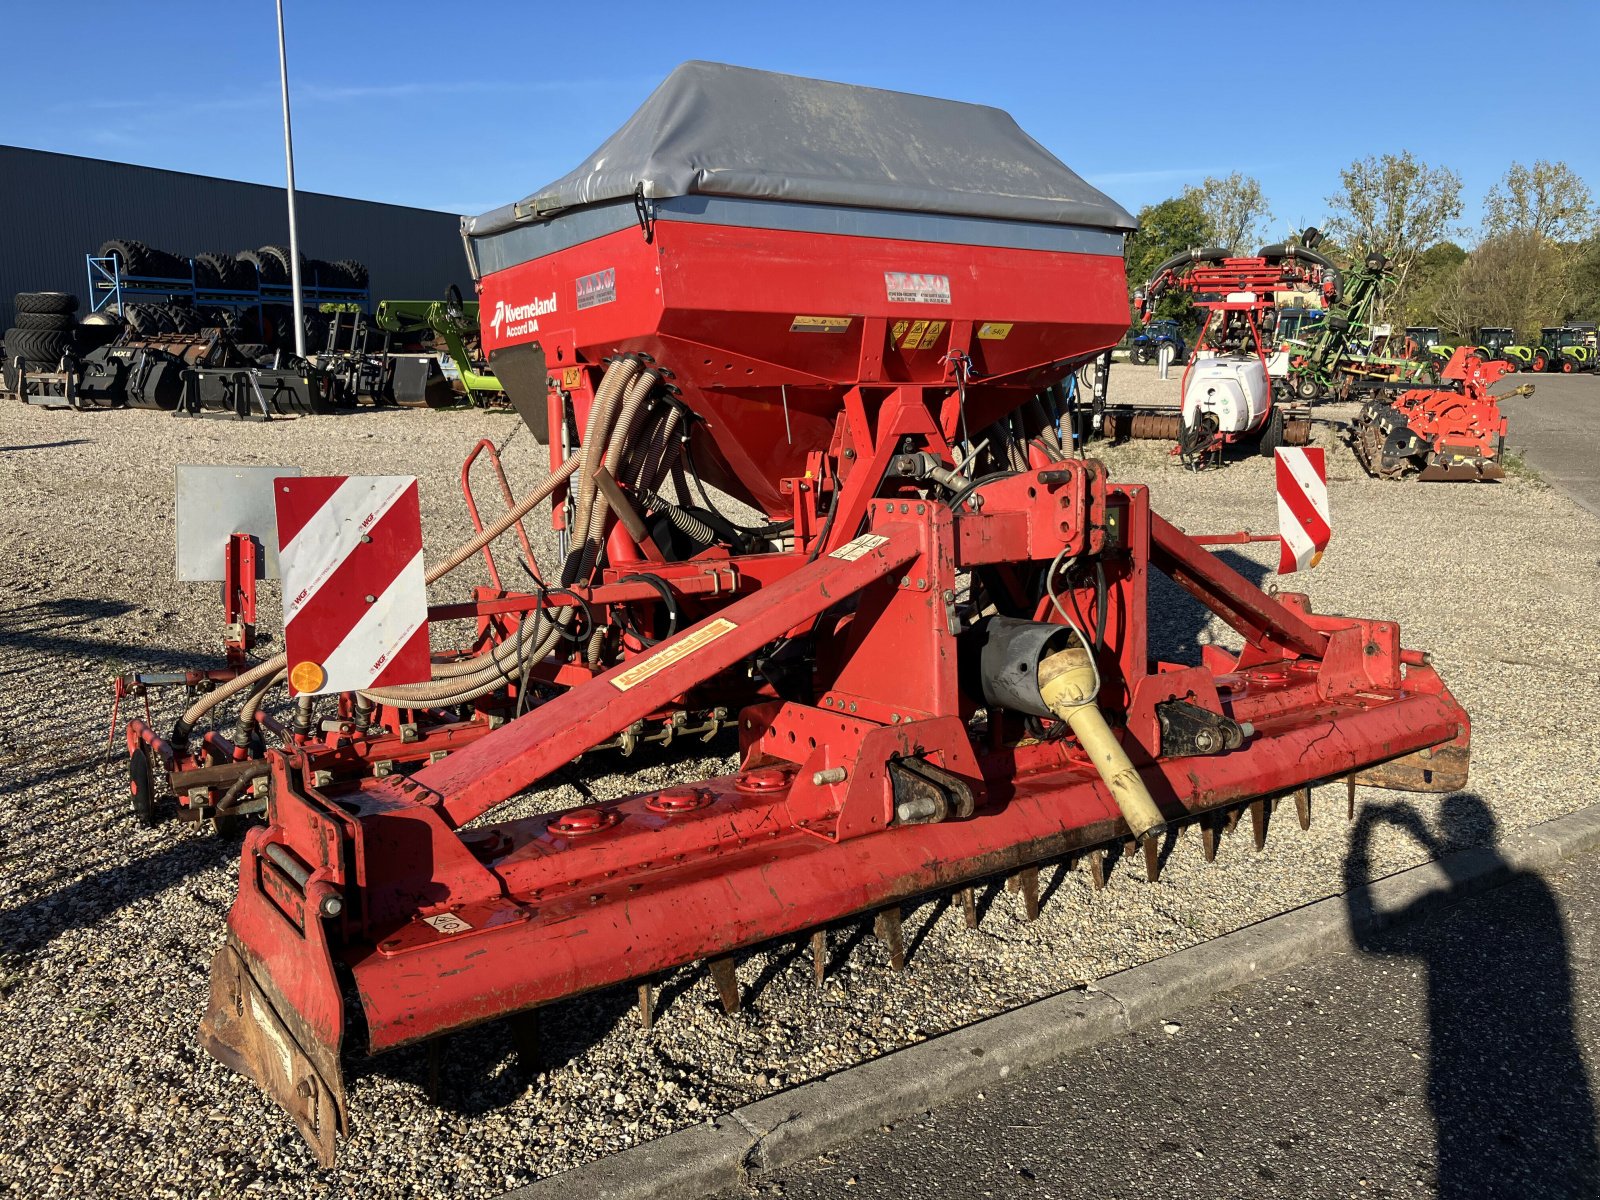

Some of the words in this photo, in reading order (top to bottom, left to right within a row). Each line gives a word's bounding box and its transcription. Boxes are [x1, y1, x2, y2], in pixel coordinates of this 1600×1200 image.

[505, 292, 557, 323] Kverneland
[506, 322, 528, 338] Accord
[528, 319, 539, 333] DA
[362, 512, 375, 527] WGF
[294, 588, 308, 604] WGF
[373, 654, 386, 669] WGF
